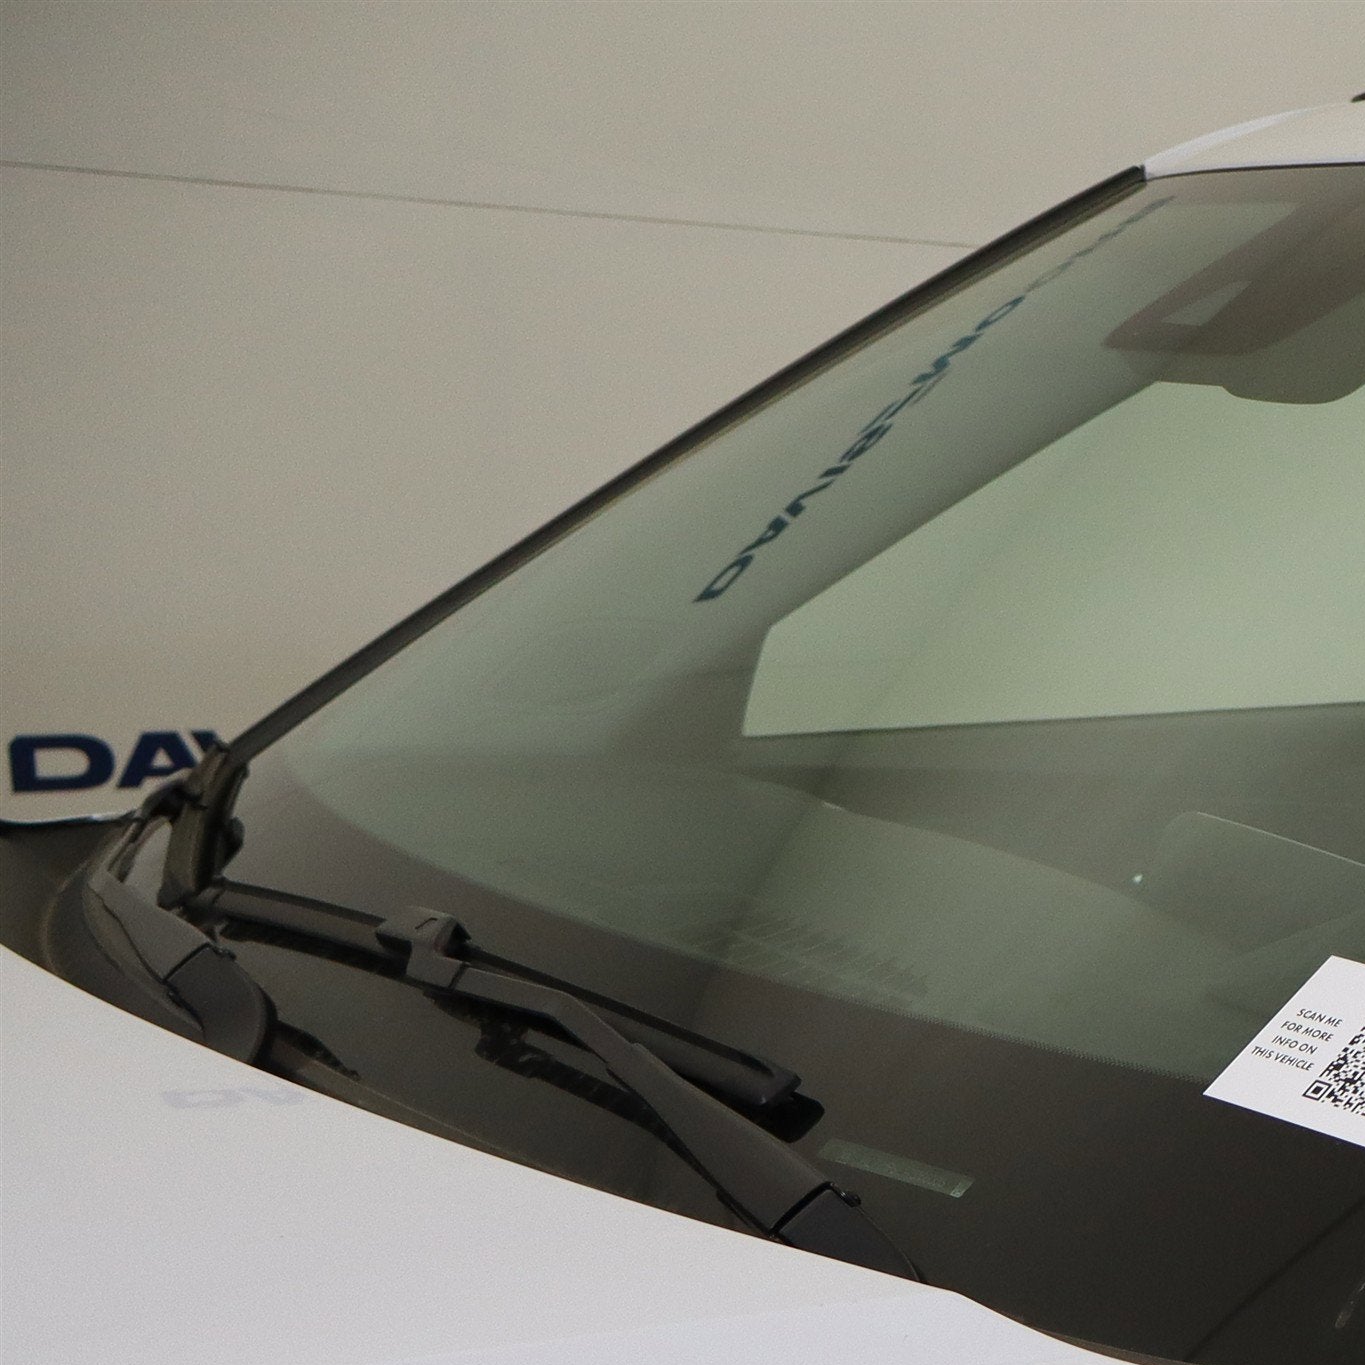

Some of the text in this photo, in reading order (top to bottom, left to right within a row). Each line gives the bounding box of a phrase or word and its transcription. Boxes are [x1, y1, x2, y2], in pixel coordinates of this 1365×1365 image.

[1296, 1008, 1343, 1028] SCAN ME
[1280, 1020, 1334, 1042] FOR MORE
[1271, 1035, 1318, 1055] INFO ON
[1251, 1045, 1315, 1071] THIS VEHICLE
